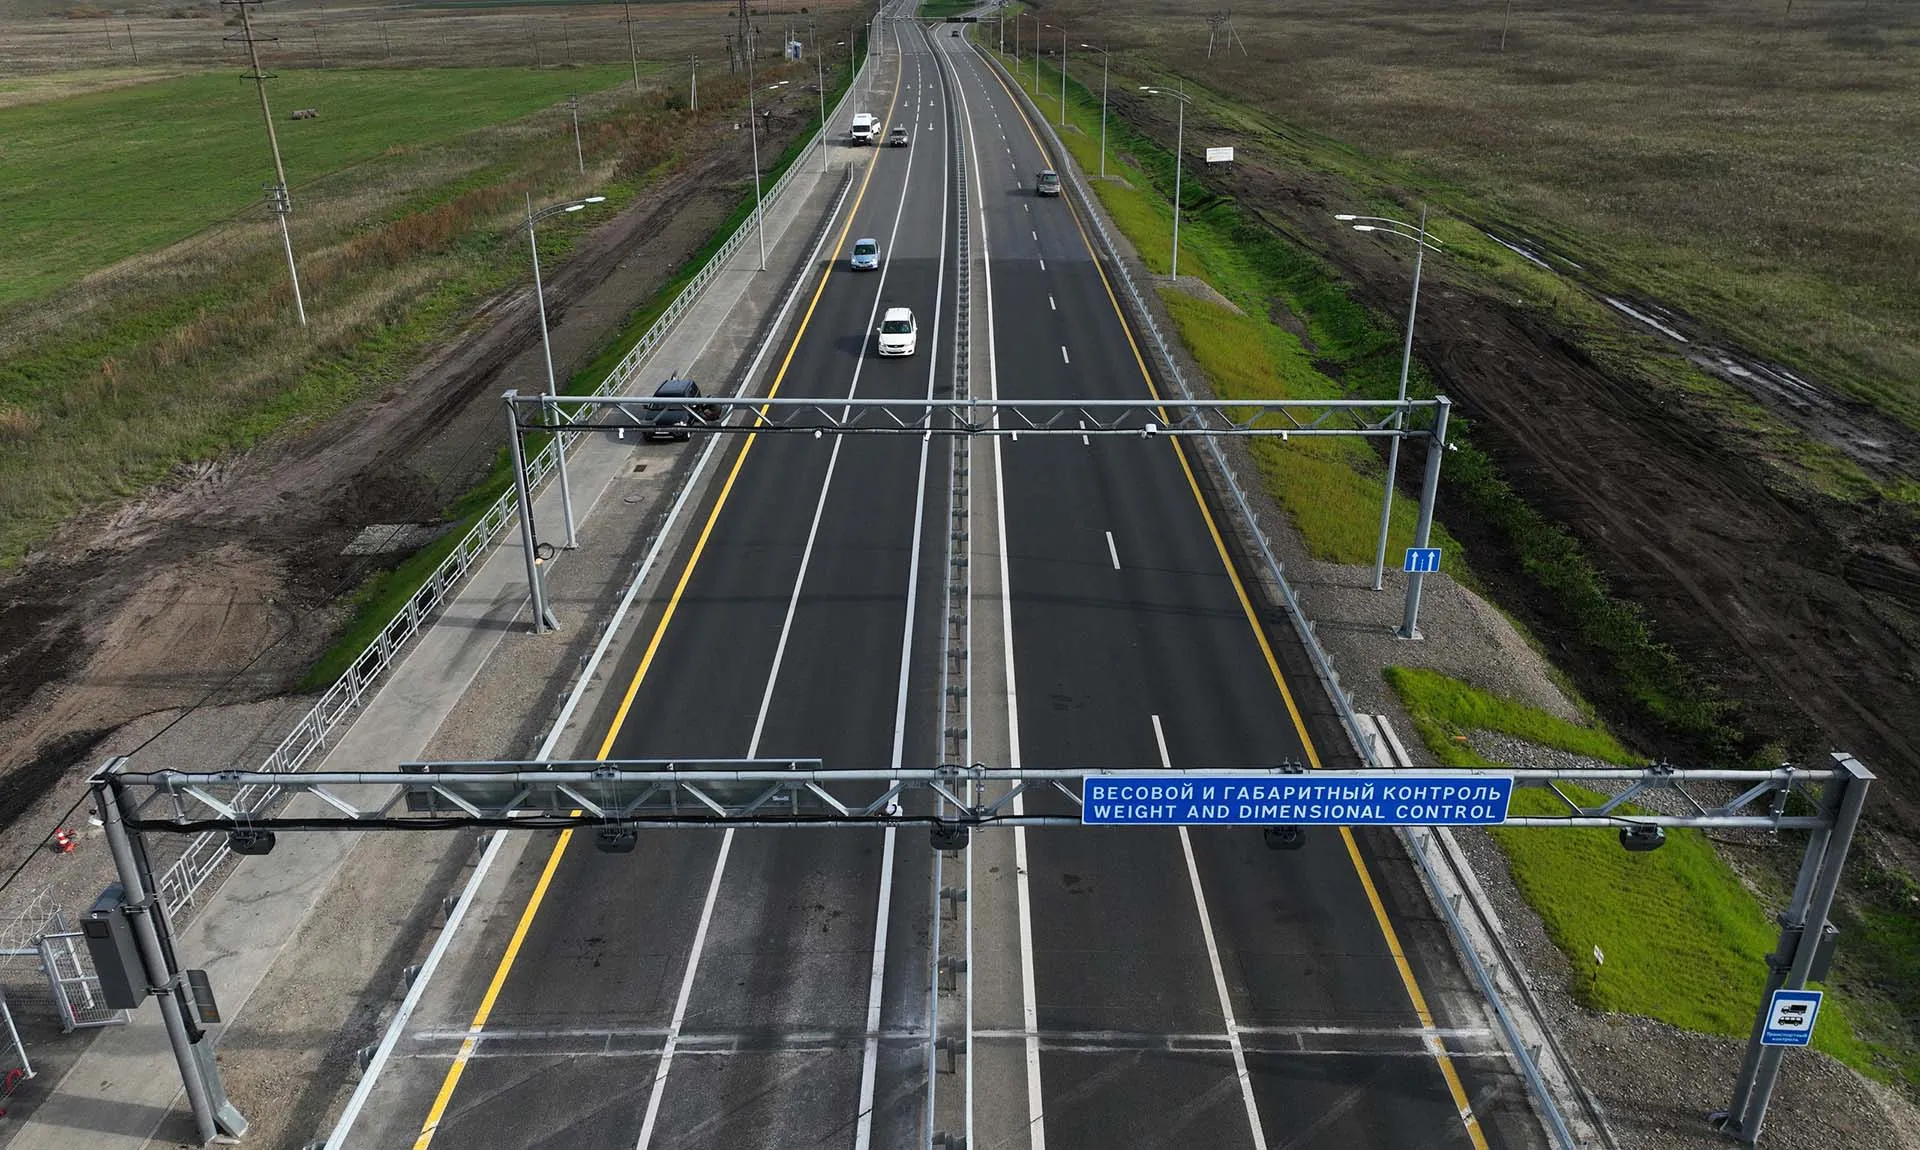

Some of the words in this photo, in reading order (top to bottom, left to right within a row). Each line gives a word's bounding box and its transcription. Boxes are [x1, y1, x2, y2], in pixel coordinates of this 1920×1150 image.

[1093, 782, 1194, 800] ВЕСОВОЙ
[1202, 786, 1215, 800] И
[1224, 782, 1375, 800] ГАБАРИТНЫЙ
[1383, 786, 1501, 800] КОНТРОЛЬ
[1094, 805, 1177, 819] WEIGHT
[1186, 805, 1230, 819] AND
[1239, 805, 1385, 819] DIMENSIONAL
[1396, 805, 1496, 819] CONTROL
